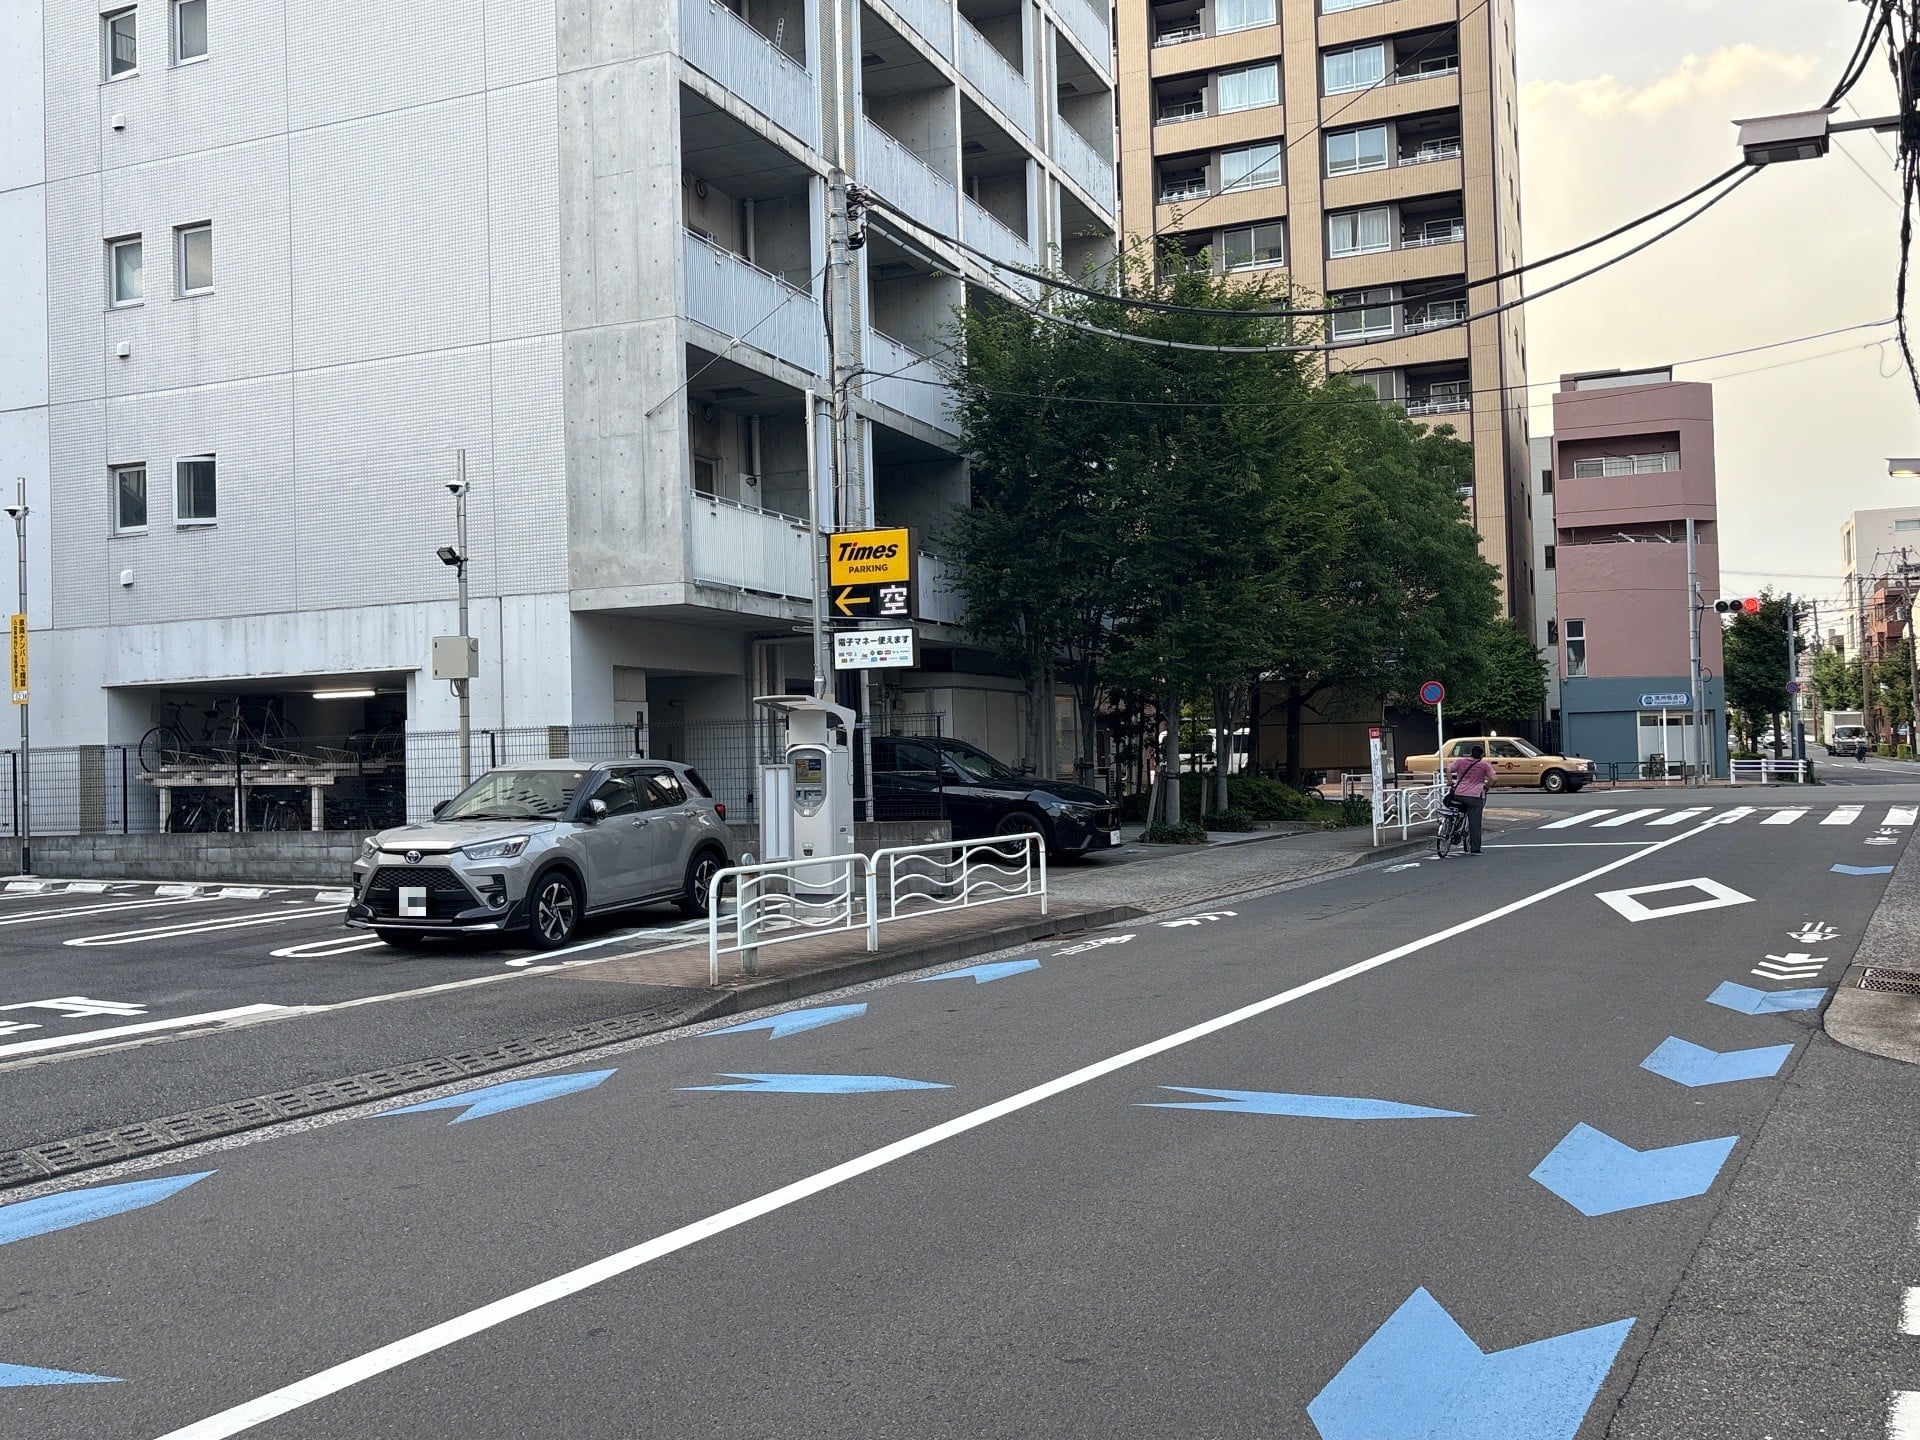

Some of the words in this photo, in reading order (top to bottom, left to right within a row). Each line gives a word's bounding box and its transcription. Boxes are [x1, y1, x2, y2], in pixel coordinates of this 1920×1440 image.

[839, 543, 898, 562] Times
[848, 564, 888, 574] PARKING
[879, 585, 908, 615] 空
[838, 635, 910, 647] 電子マネー使えます
